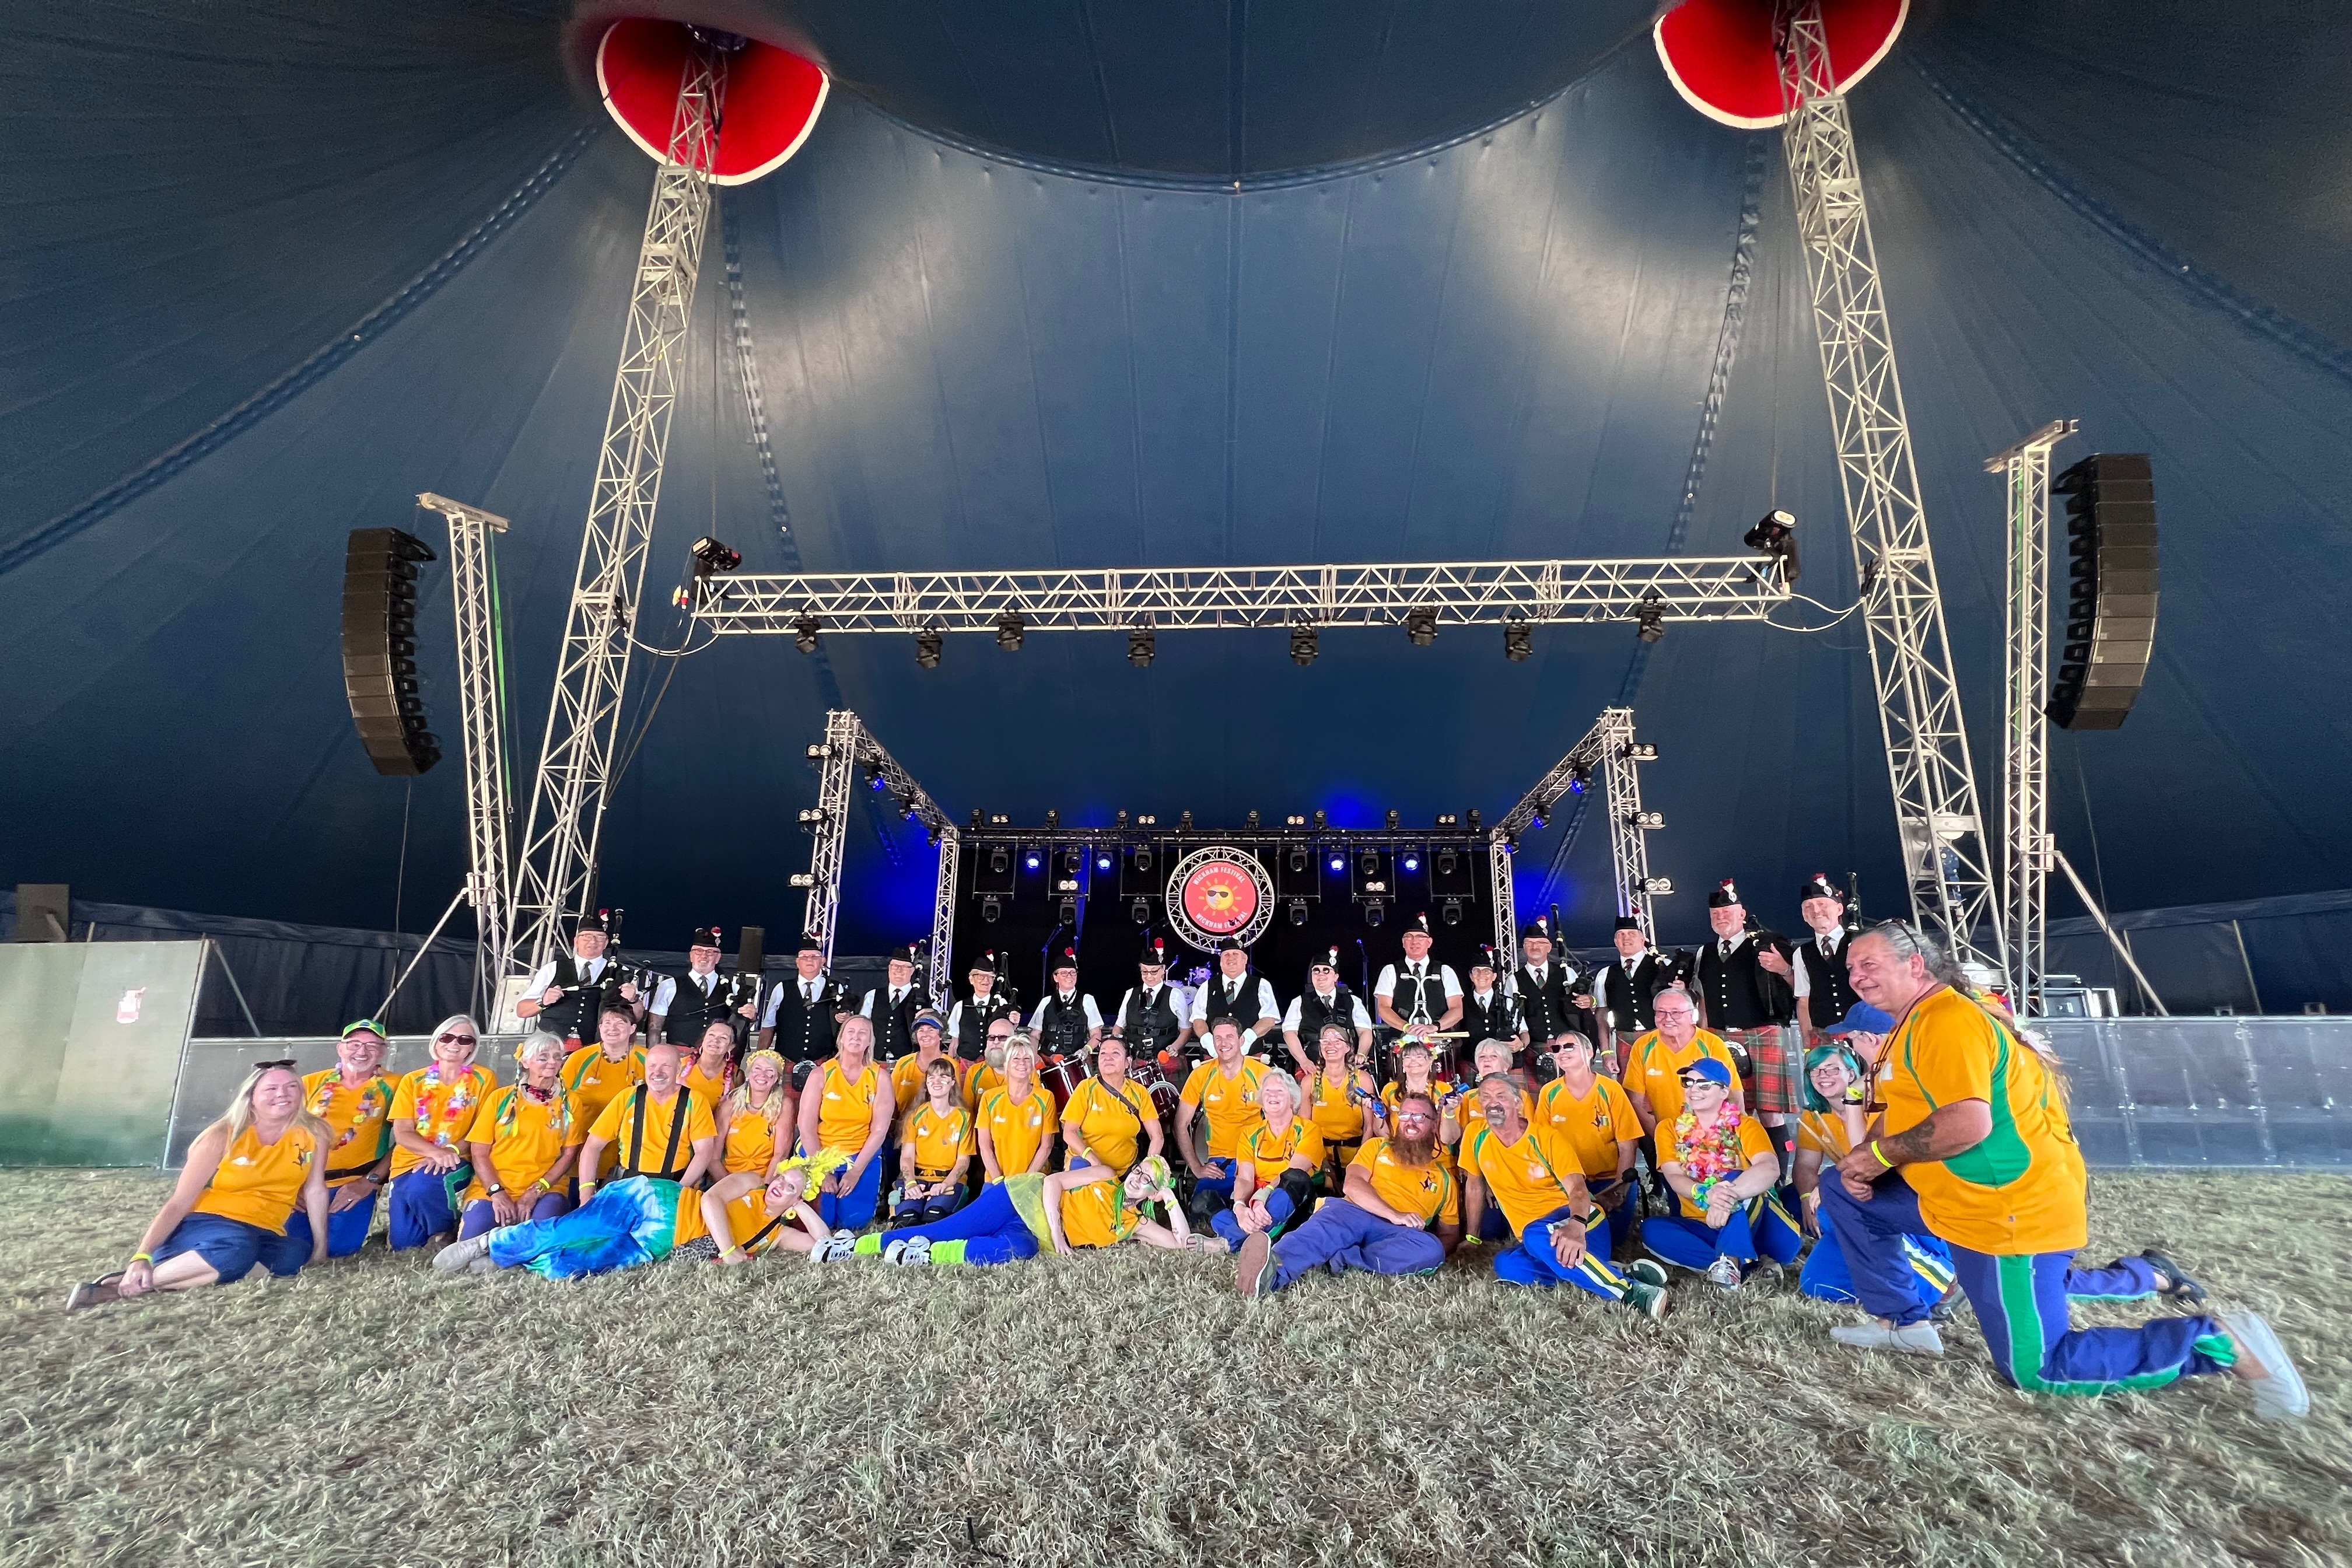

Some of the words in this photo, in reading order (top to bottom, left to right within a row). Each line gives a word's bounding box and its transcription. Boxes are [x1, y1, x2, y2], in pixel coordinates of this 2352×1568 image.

[1192, 866, 1219, 886] WICKHAM
[1220, 866, 1245, 884] FESTIVAL
[1195, 912, 1223, 929] WICKHAM
